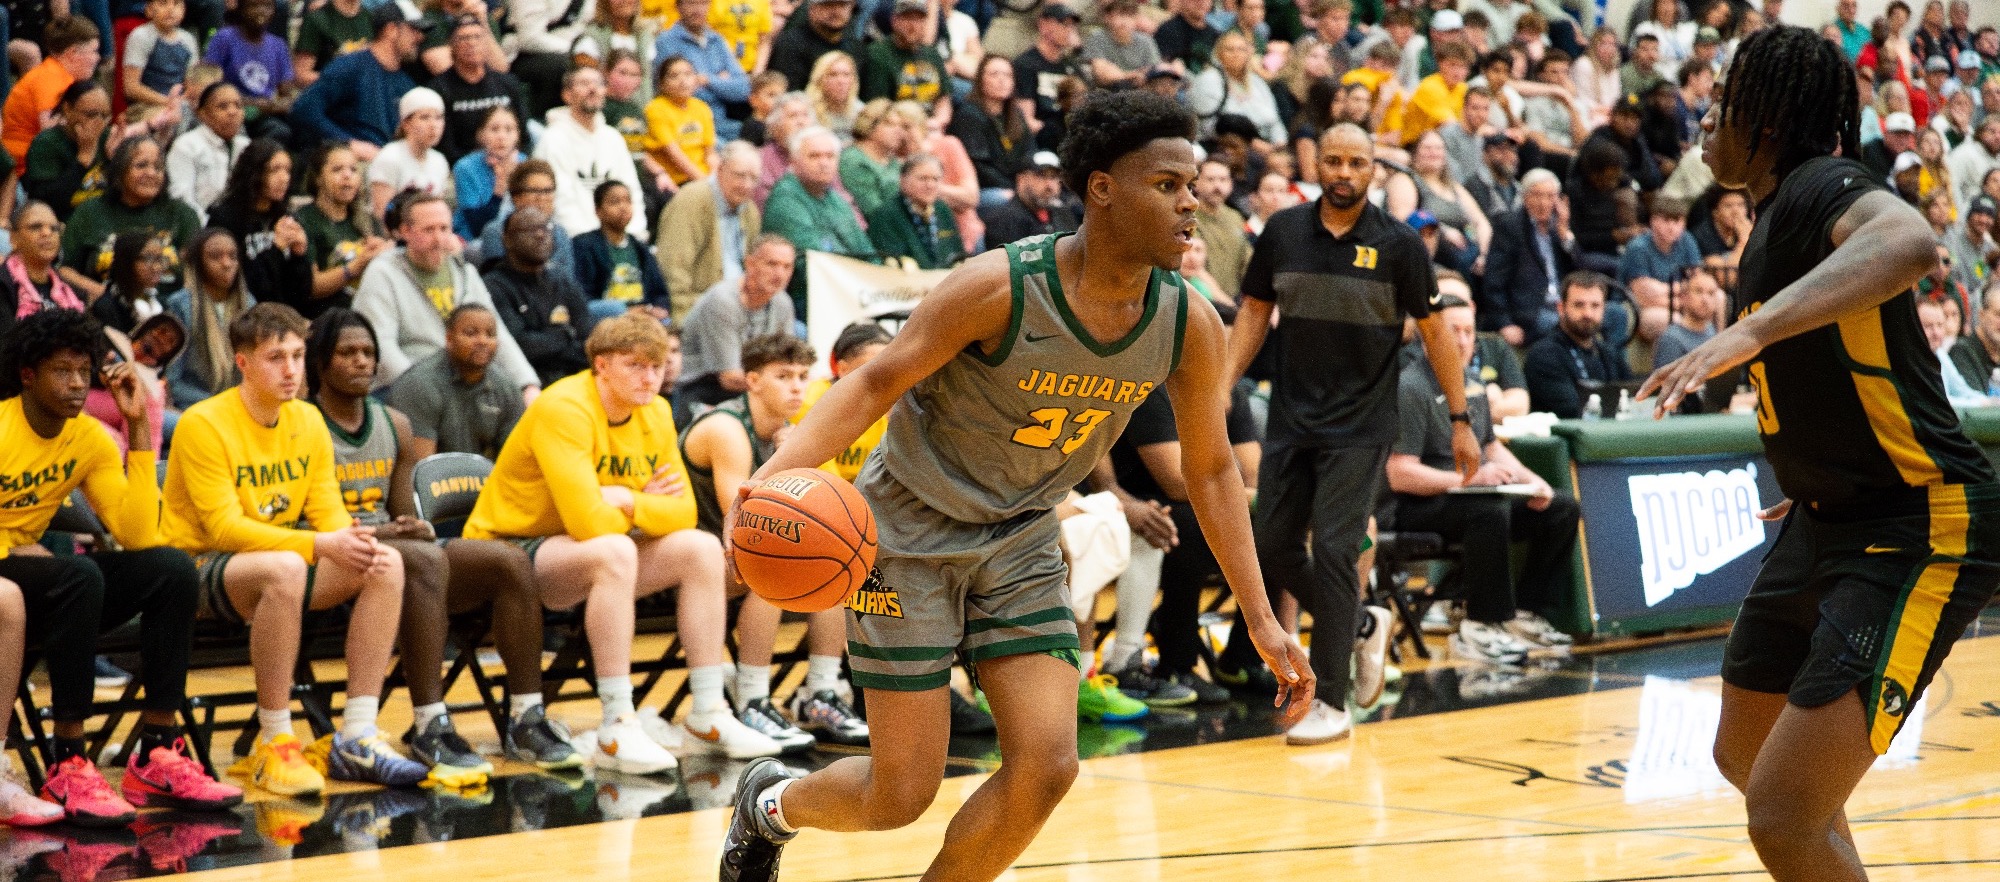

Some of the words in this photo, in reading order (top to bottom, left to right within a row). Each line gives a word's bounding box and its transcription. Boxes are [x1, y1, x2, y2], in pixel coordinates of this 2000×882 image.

[1017, 368, 1154, 403] JAGUARS
[1010, 407, 1114, 455] 23
[236, 454, 310, 488] FAMILY
[736, 508, 806, 544] SPALDIN
